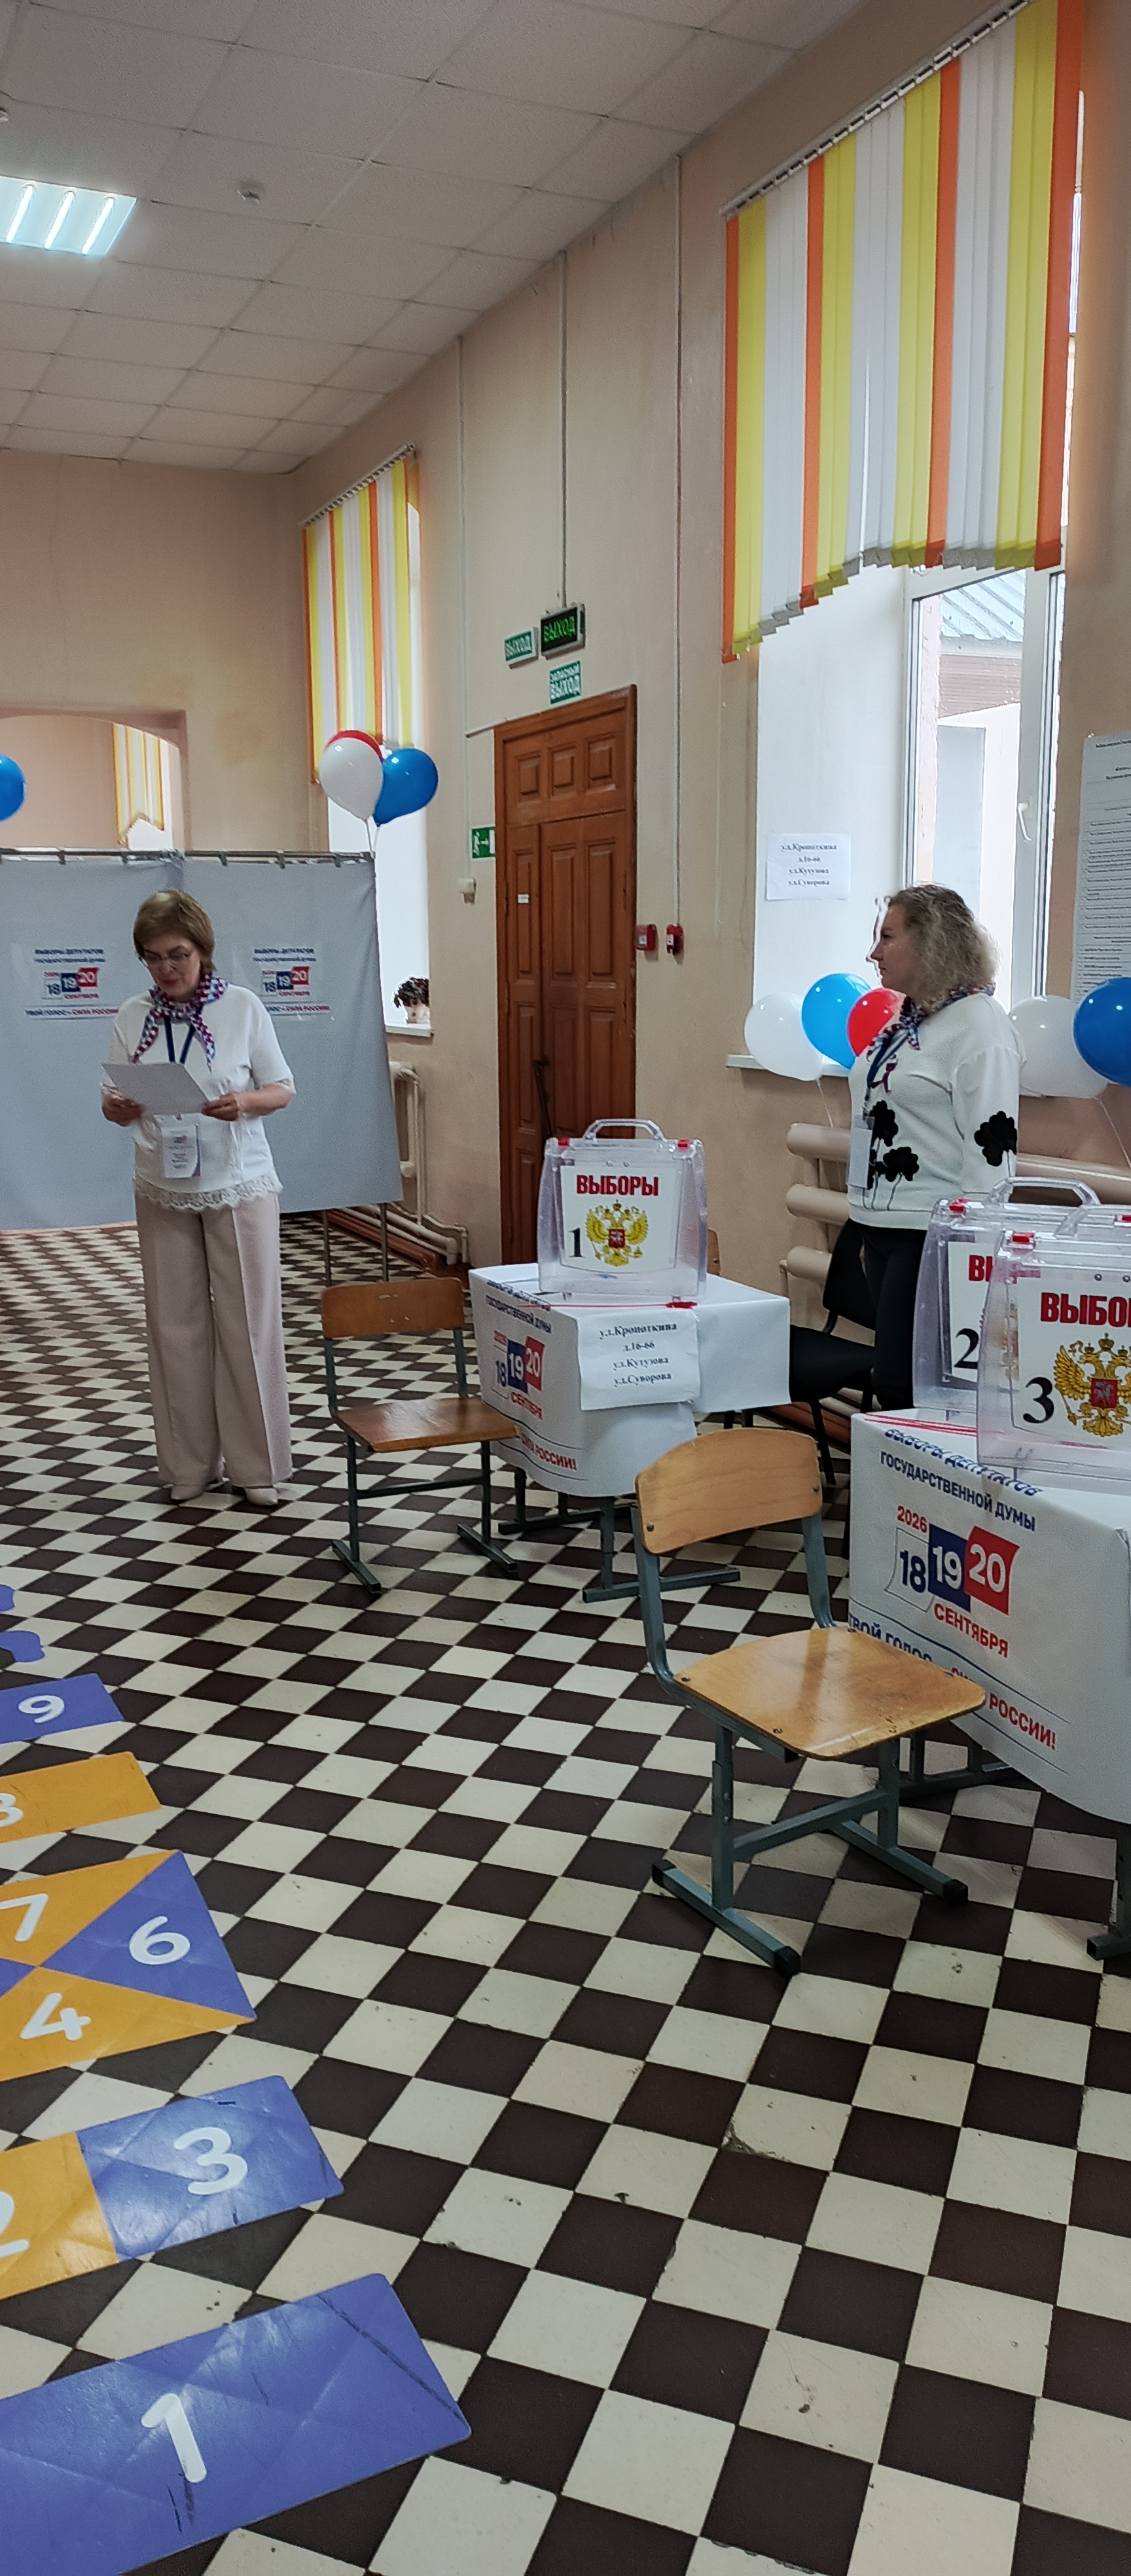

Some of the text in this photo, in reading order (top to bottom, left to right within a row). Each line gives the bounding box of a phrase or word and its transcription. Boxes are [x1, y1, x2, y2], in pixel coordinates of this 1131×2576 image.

[544, 616, 575, 643] ВЫХОД
[77, 972, 96, 984] 20
[291, 970, 308, 981] 20
[577, 1174, 658, 1196] ВЫБОРЫ
[568, 1228, 585, 1258] 1
[1041, 1292, 1131, 1327] ВЫБО
[495, 1348, 541, 1387] 18 19 20
[954, 1328, 979, 1370] 2
[1022, 1376, 1055, 1424] 3
[885, 1429, 945, 1458] ВЫБОРЫ
[881, 1450, 1035, 1532] ГОСУДАРСТВЕННОЙ ДУМЫ
[897, 1505, 928, 1533] 2026
[899, 1543, 1007, 1594] 18 19 20
[934, 1603, 1009, 1658] СЕНТЯБРЯ
[18, 1695, 65, 1724] 9
[989, 1692, 1056, 1751] РОССИИ!
[0, 1893, 49, 1942] 7
[129, 1916, 190, 1965] 6
[20, 1992, 92, 2041] 4
[173, 2126, 248, 2196] 3
[141, 2393, 207, 2483] 1
